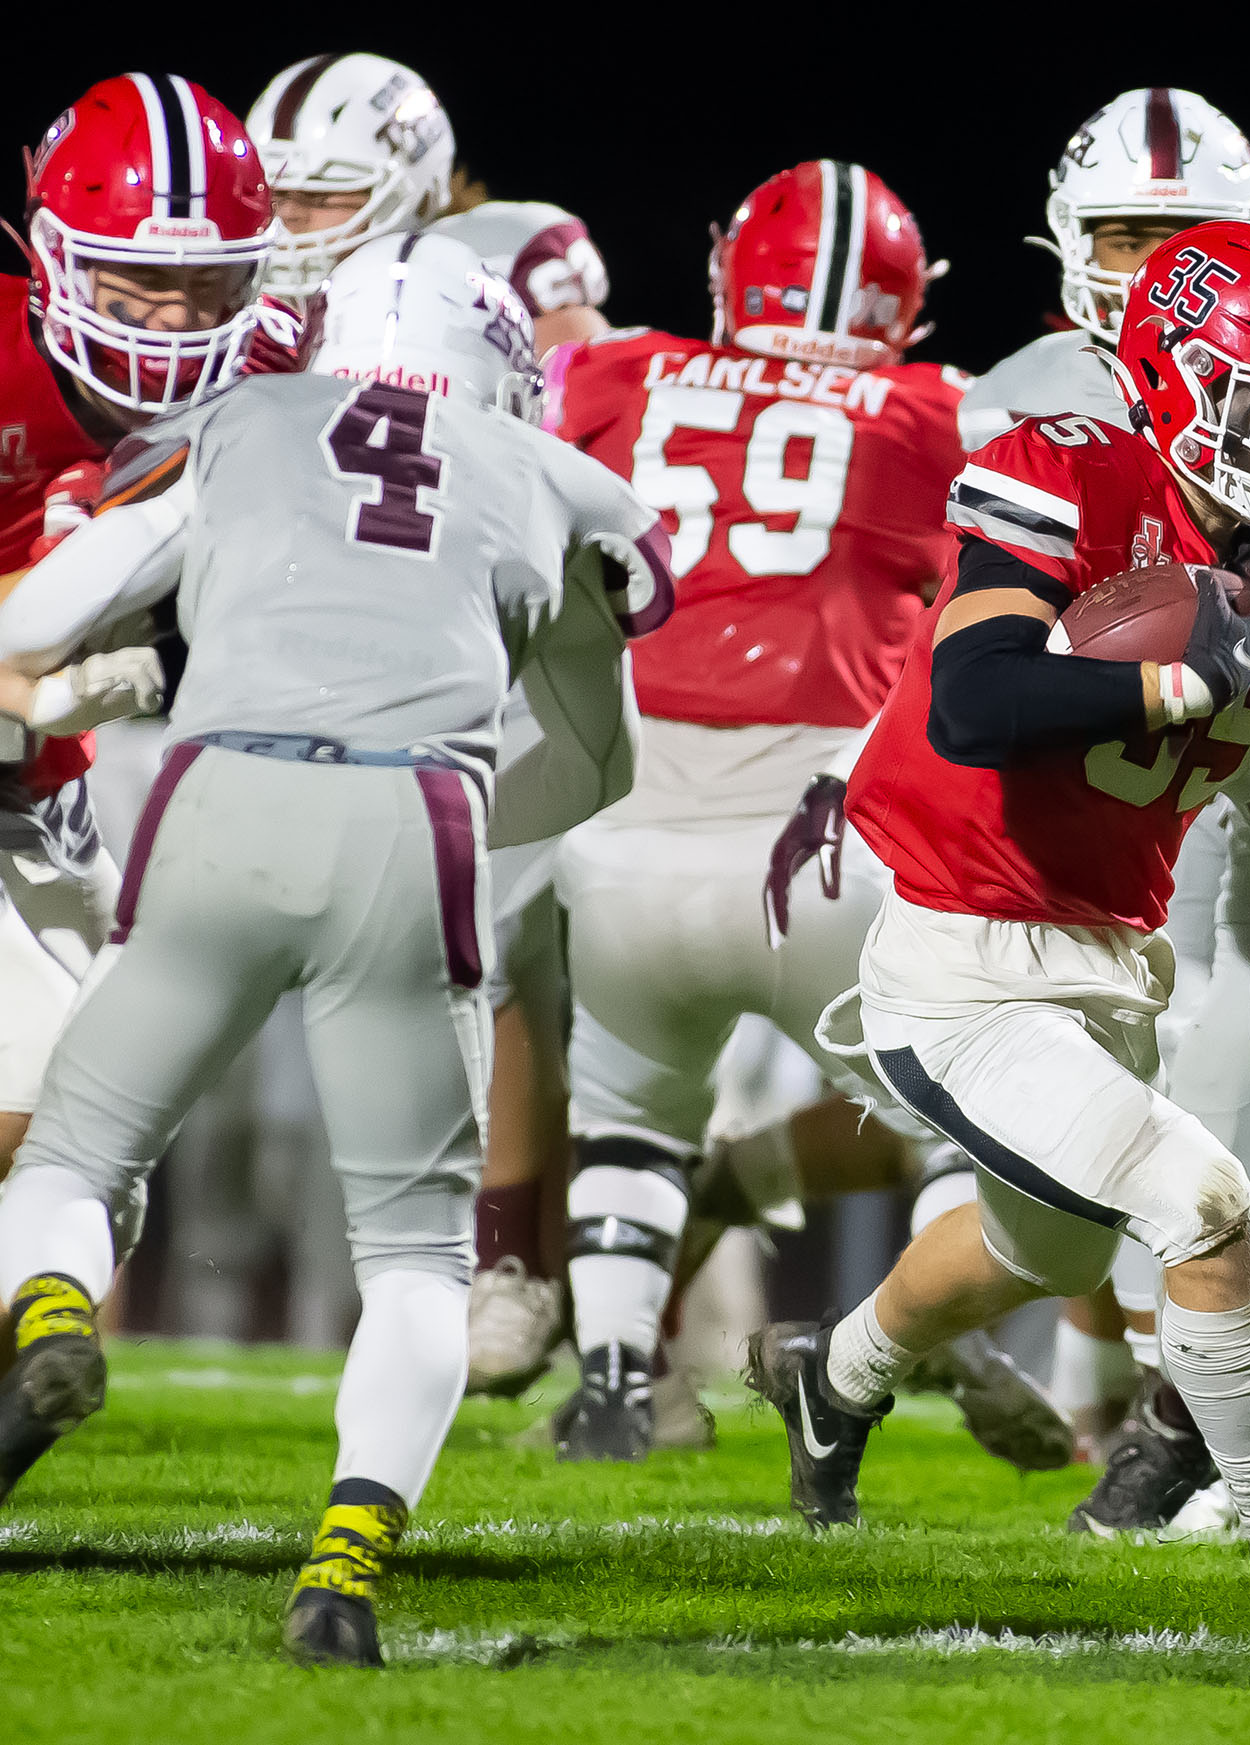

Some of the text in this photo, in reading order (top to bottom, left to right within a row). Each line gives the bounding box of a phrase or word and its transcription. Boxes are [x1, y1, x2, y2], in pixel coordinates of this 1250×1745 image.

[1148, 246, 1241, 329] 35
[321, 382, 449, 561] 4
[631, 387, 855, 577] 59
